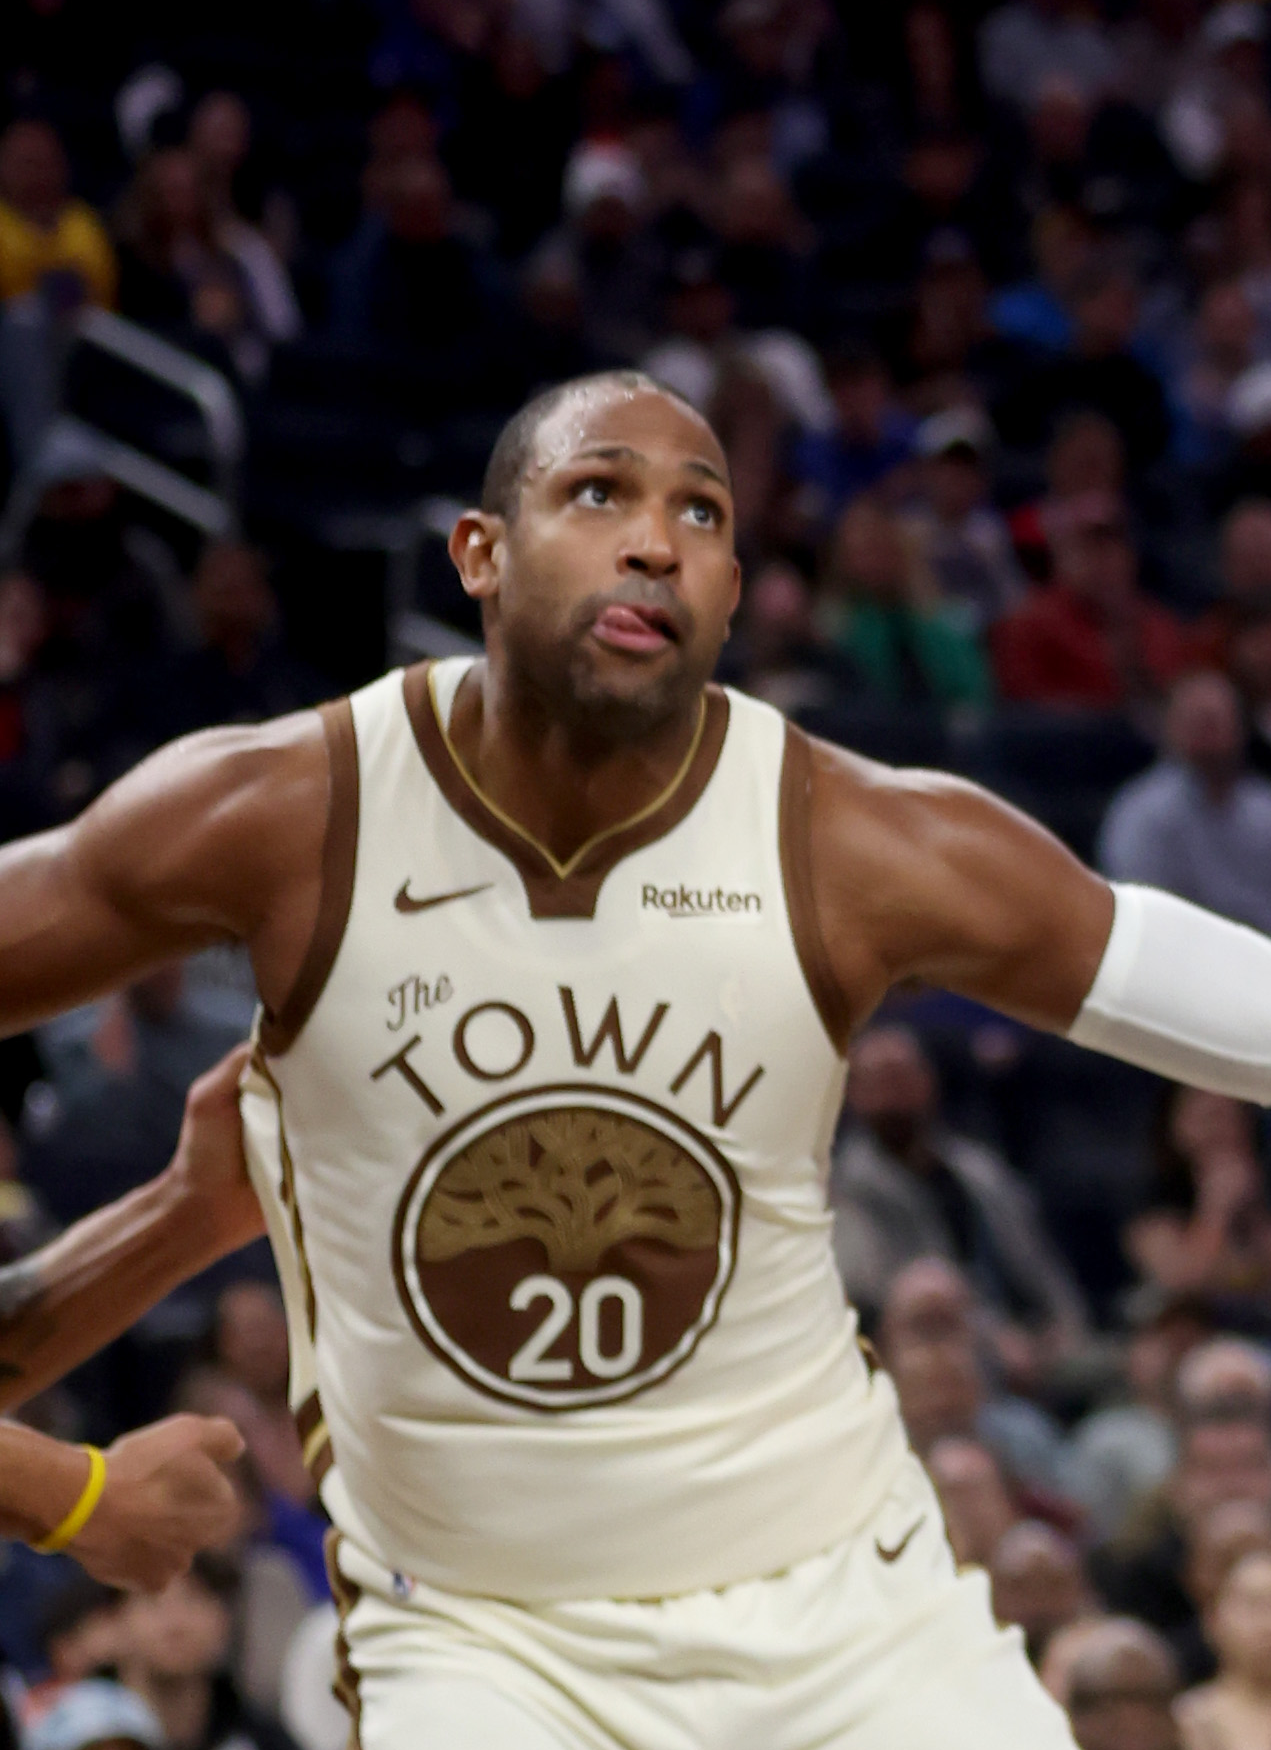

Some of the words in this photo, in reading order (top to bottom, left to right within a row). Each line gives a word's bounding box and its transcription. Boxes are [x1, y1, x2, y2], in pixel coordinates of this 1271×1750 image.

[642, 883, 761, 913] Rakuten
[386, 974, 455, 1032] The
[370, 986, 766, 1129] TOWN
[508, 1274, 644, 1382] 20
